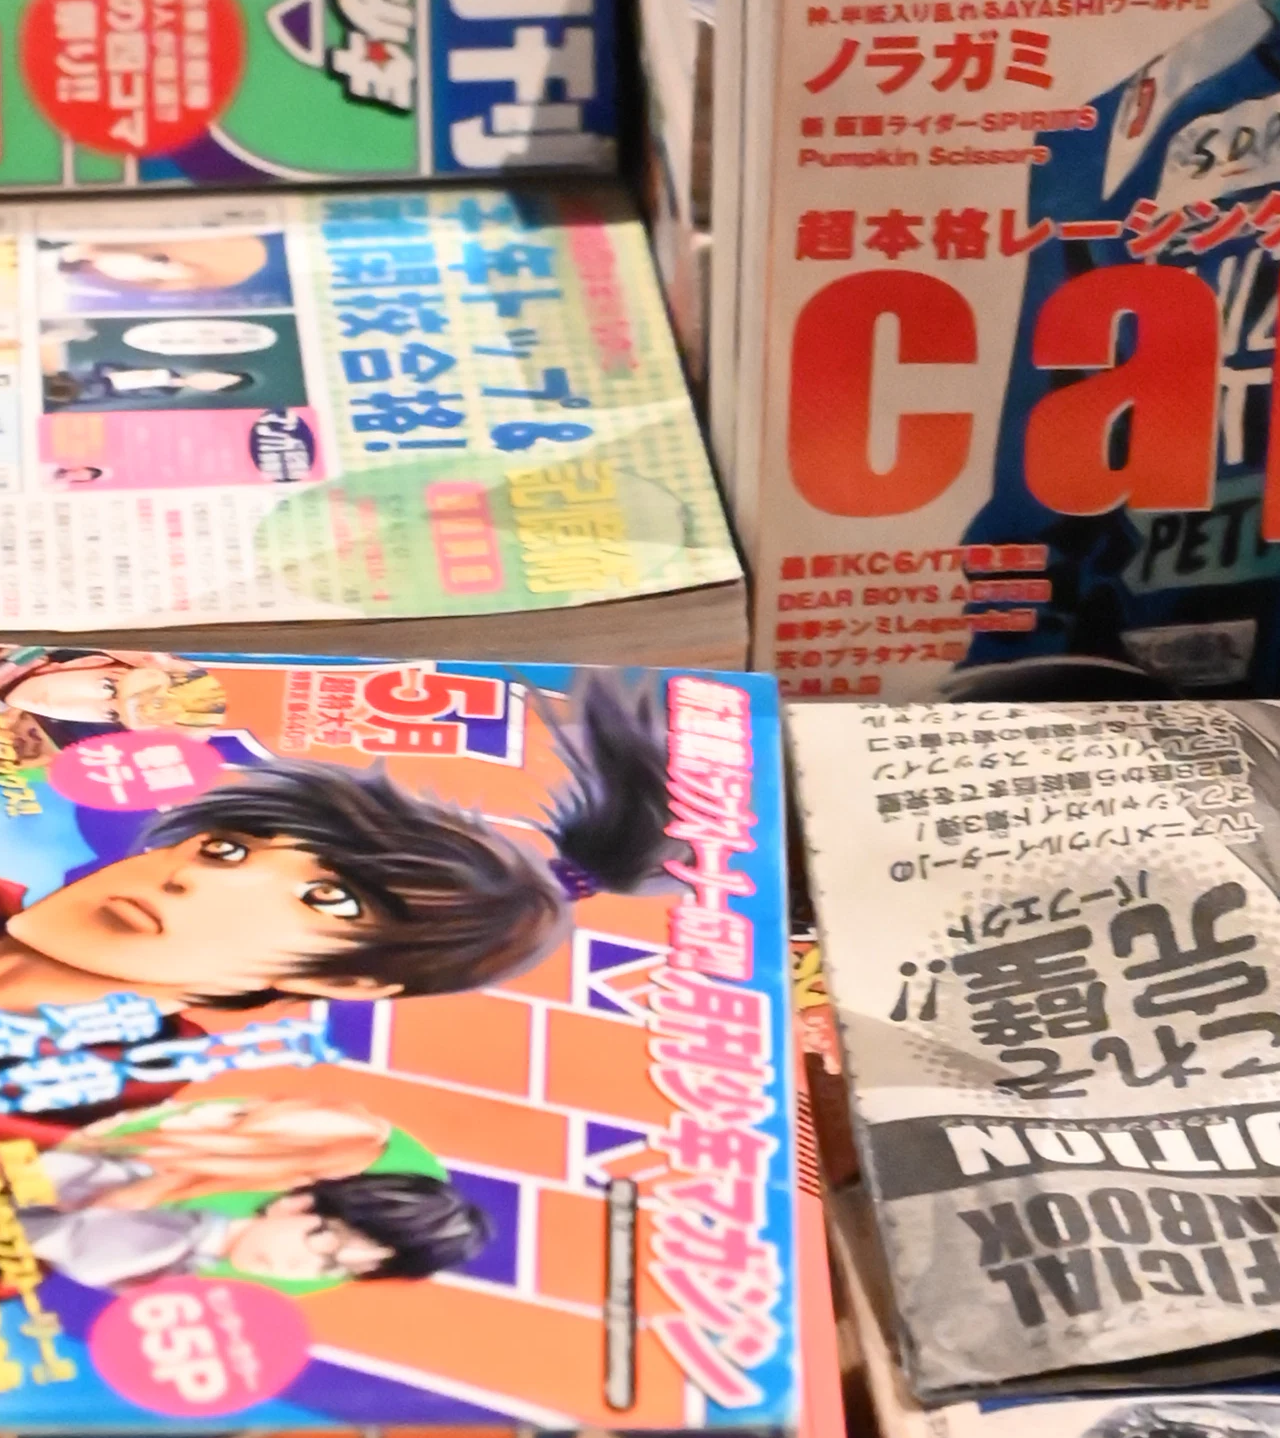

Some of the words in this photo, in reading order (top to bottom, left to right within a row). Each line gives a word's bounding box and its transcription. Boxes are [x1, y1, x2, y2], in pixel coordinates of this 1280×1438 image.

[804, 28, 1055, 95] ノラガミ
[797, 146, 918, 168] Pumpkin
[928, 142, 1053, 167] Scissors
[776, 586, 855, 614] DEAR
[862, 584, 940, 606] BOYS
[311, 675, 357, 747] 超特大号
[363, 664, 510, 758] 5月
[75, 744, 130, 806] カラー
[888, 808, 1264, 885] TVアニメ「ソウルイーター」の
[946, 867, 1153, 942] パーフェクト
[647, 978, 788, 1408] 月刊少年マガジン
[131, 1287, 229, 1407] 65P
